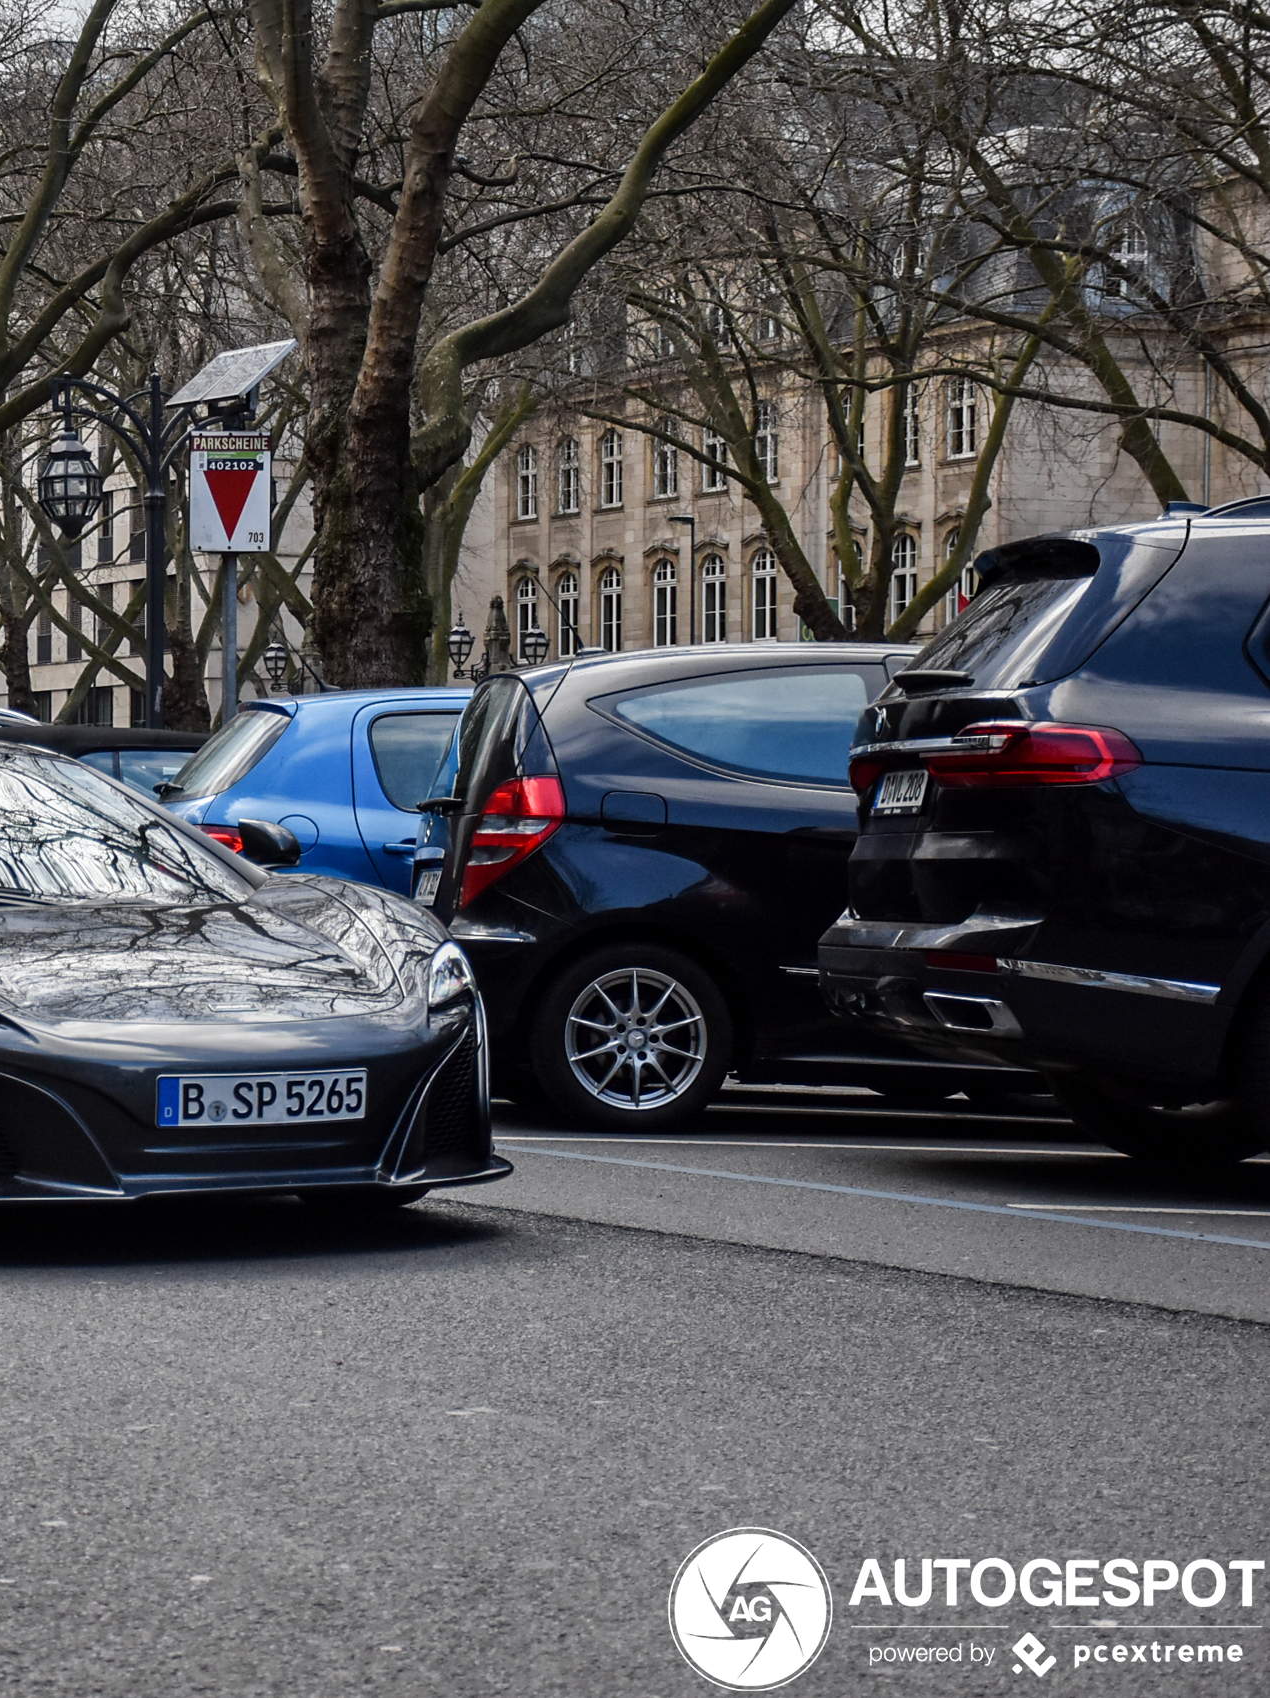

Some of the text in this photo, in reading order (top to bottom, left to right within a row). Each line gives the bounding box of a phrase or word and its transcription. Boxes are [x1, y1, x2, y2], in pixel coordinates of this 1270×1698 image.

[193, 437, 268, 450] PARKSCHEINE
[209, 461, 254, 470] 402102
[248, 532, 264, 543] 703
[903, 773, 925, 801] 208
[182, 1077, 363, 1120] B SP 5265
[164, 1107, 172, 1117] D
